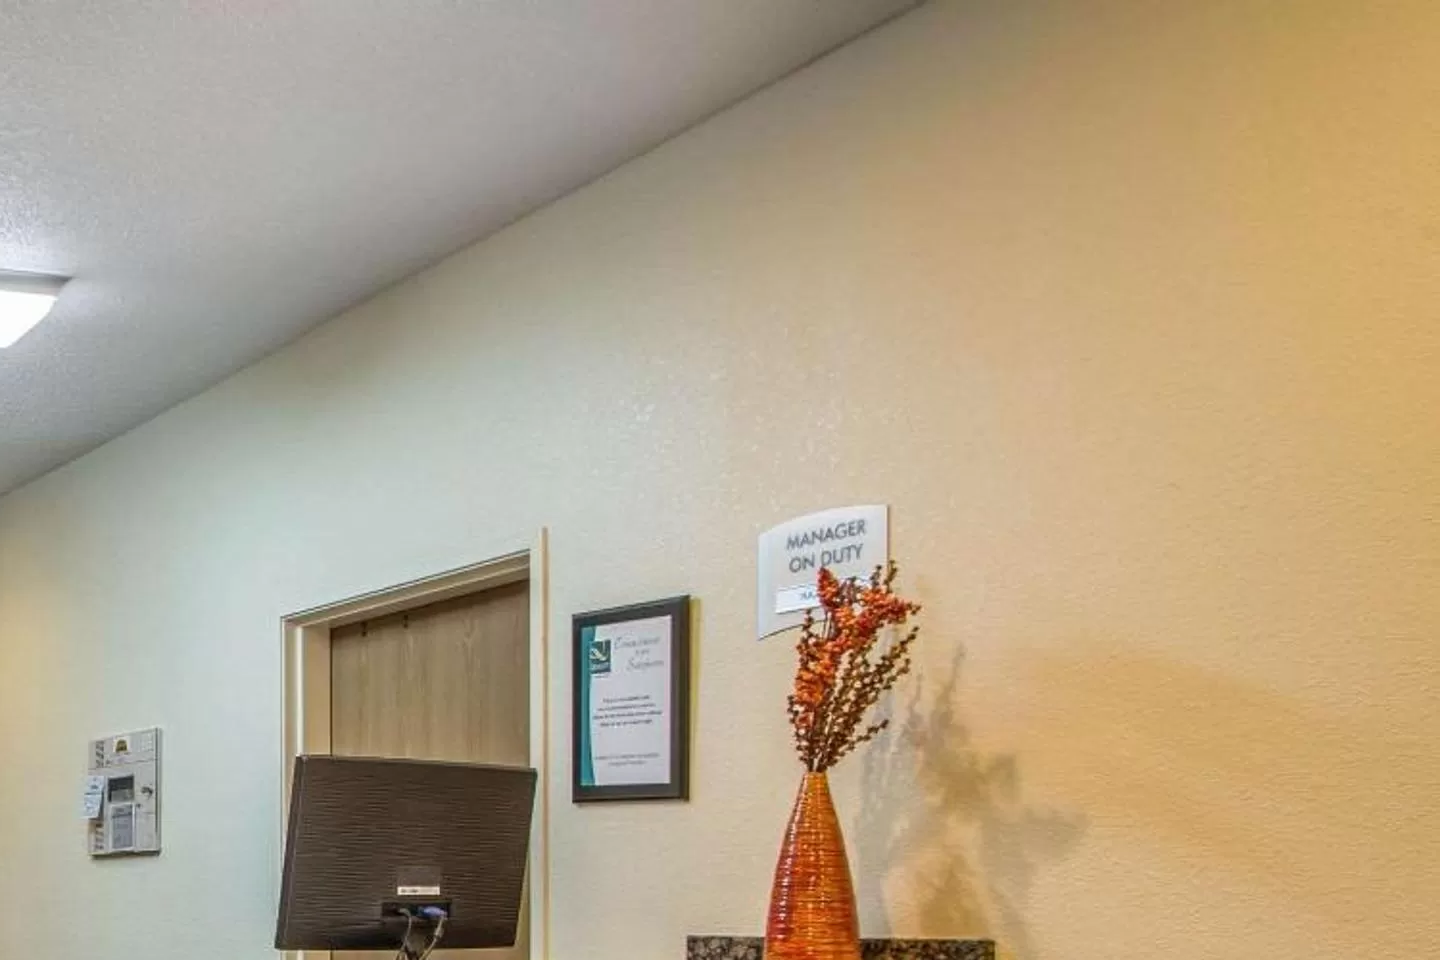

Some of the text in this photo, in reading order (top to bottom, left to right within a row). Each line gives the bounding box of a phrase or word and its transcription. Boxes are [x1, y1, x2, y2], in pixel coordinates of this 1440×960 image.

[786, 519, 867, 550] MANAGER
[788, 543, 864, 573] ON DUTY
